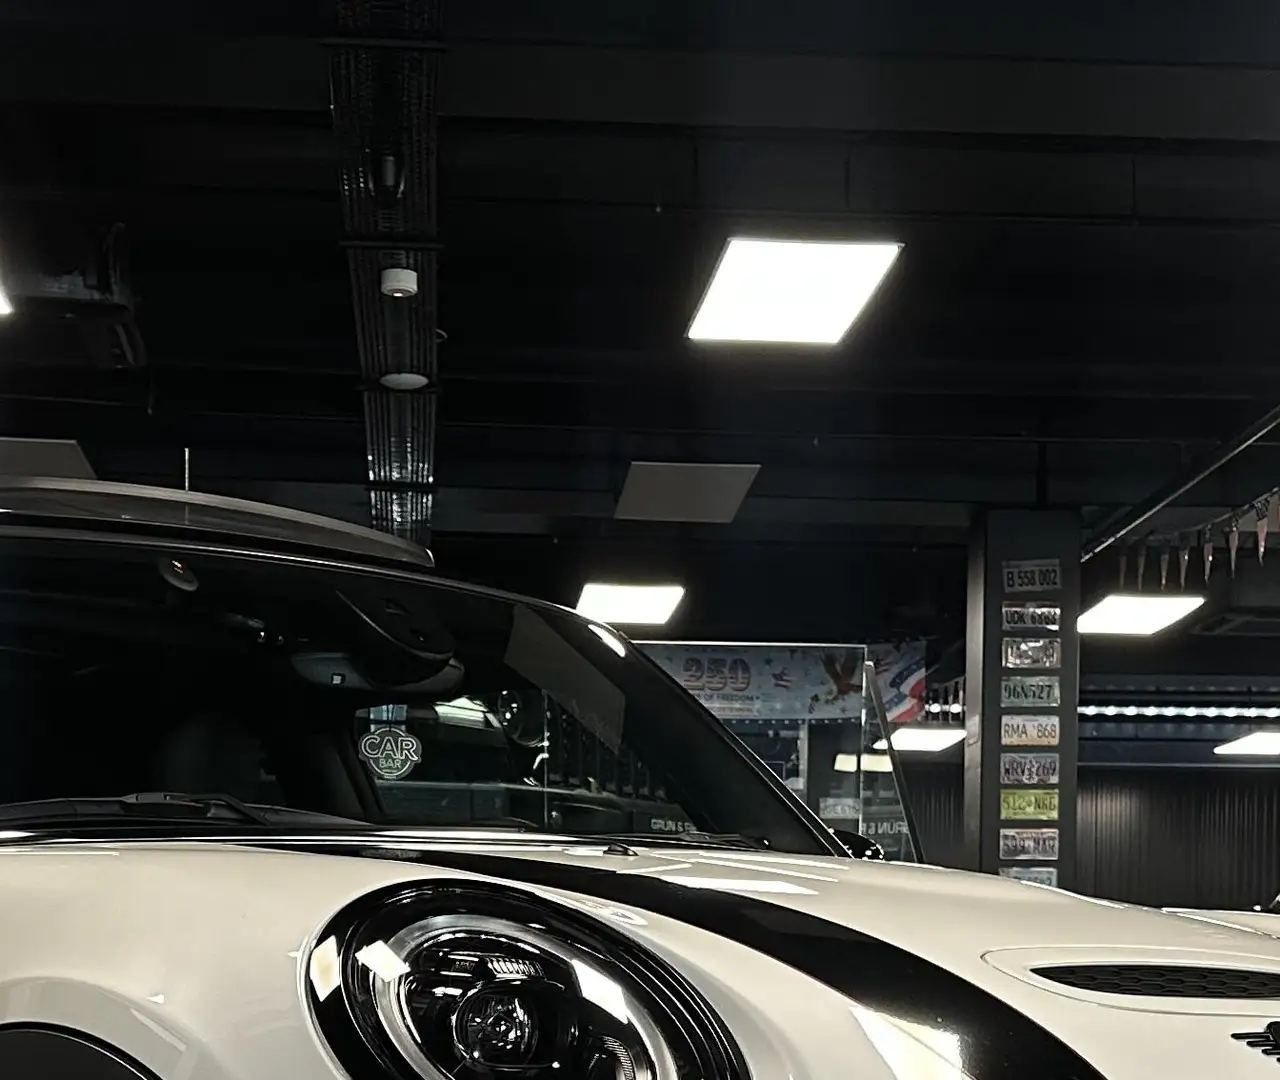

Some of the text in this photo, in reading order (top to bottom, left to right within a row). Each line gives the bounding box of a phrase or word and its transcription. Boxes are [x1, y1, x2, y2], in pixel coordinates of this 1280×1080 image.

[682, 656, 751, 692] 250
[1003, 722, 1057, 739] RMA 868
[361, 735, 418, 761] CAR
[379, 758, 402, 769] BAR
[1035, 760, 1057, 777] 269
